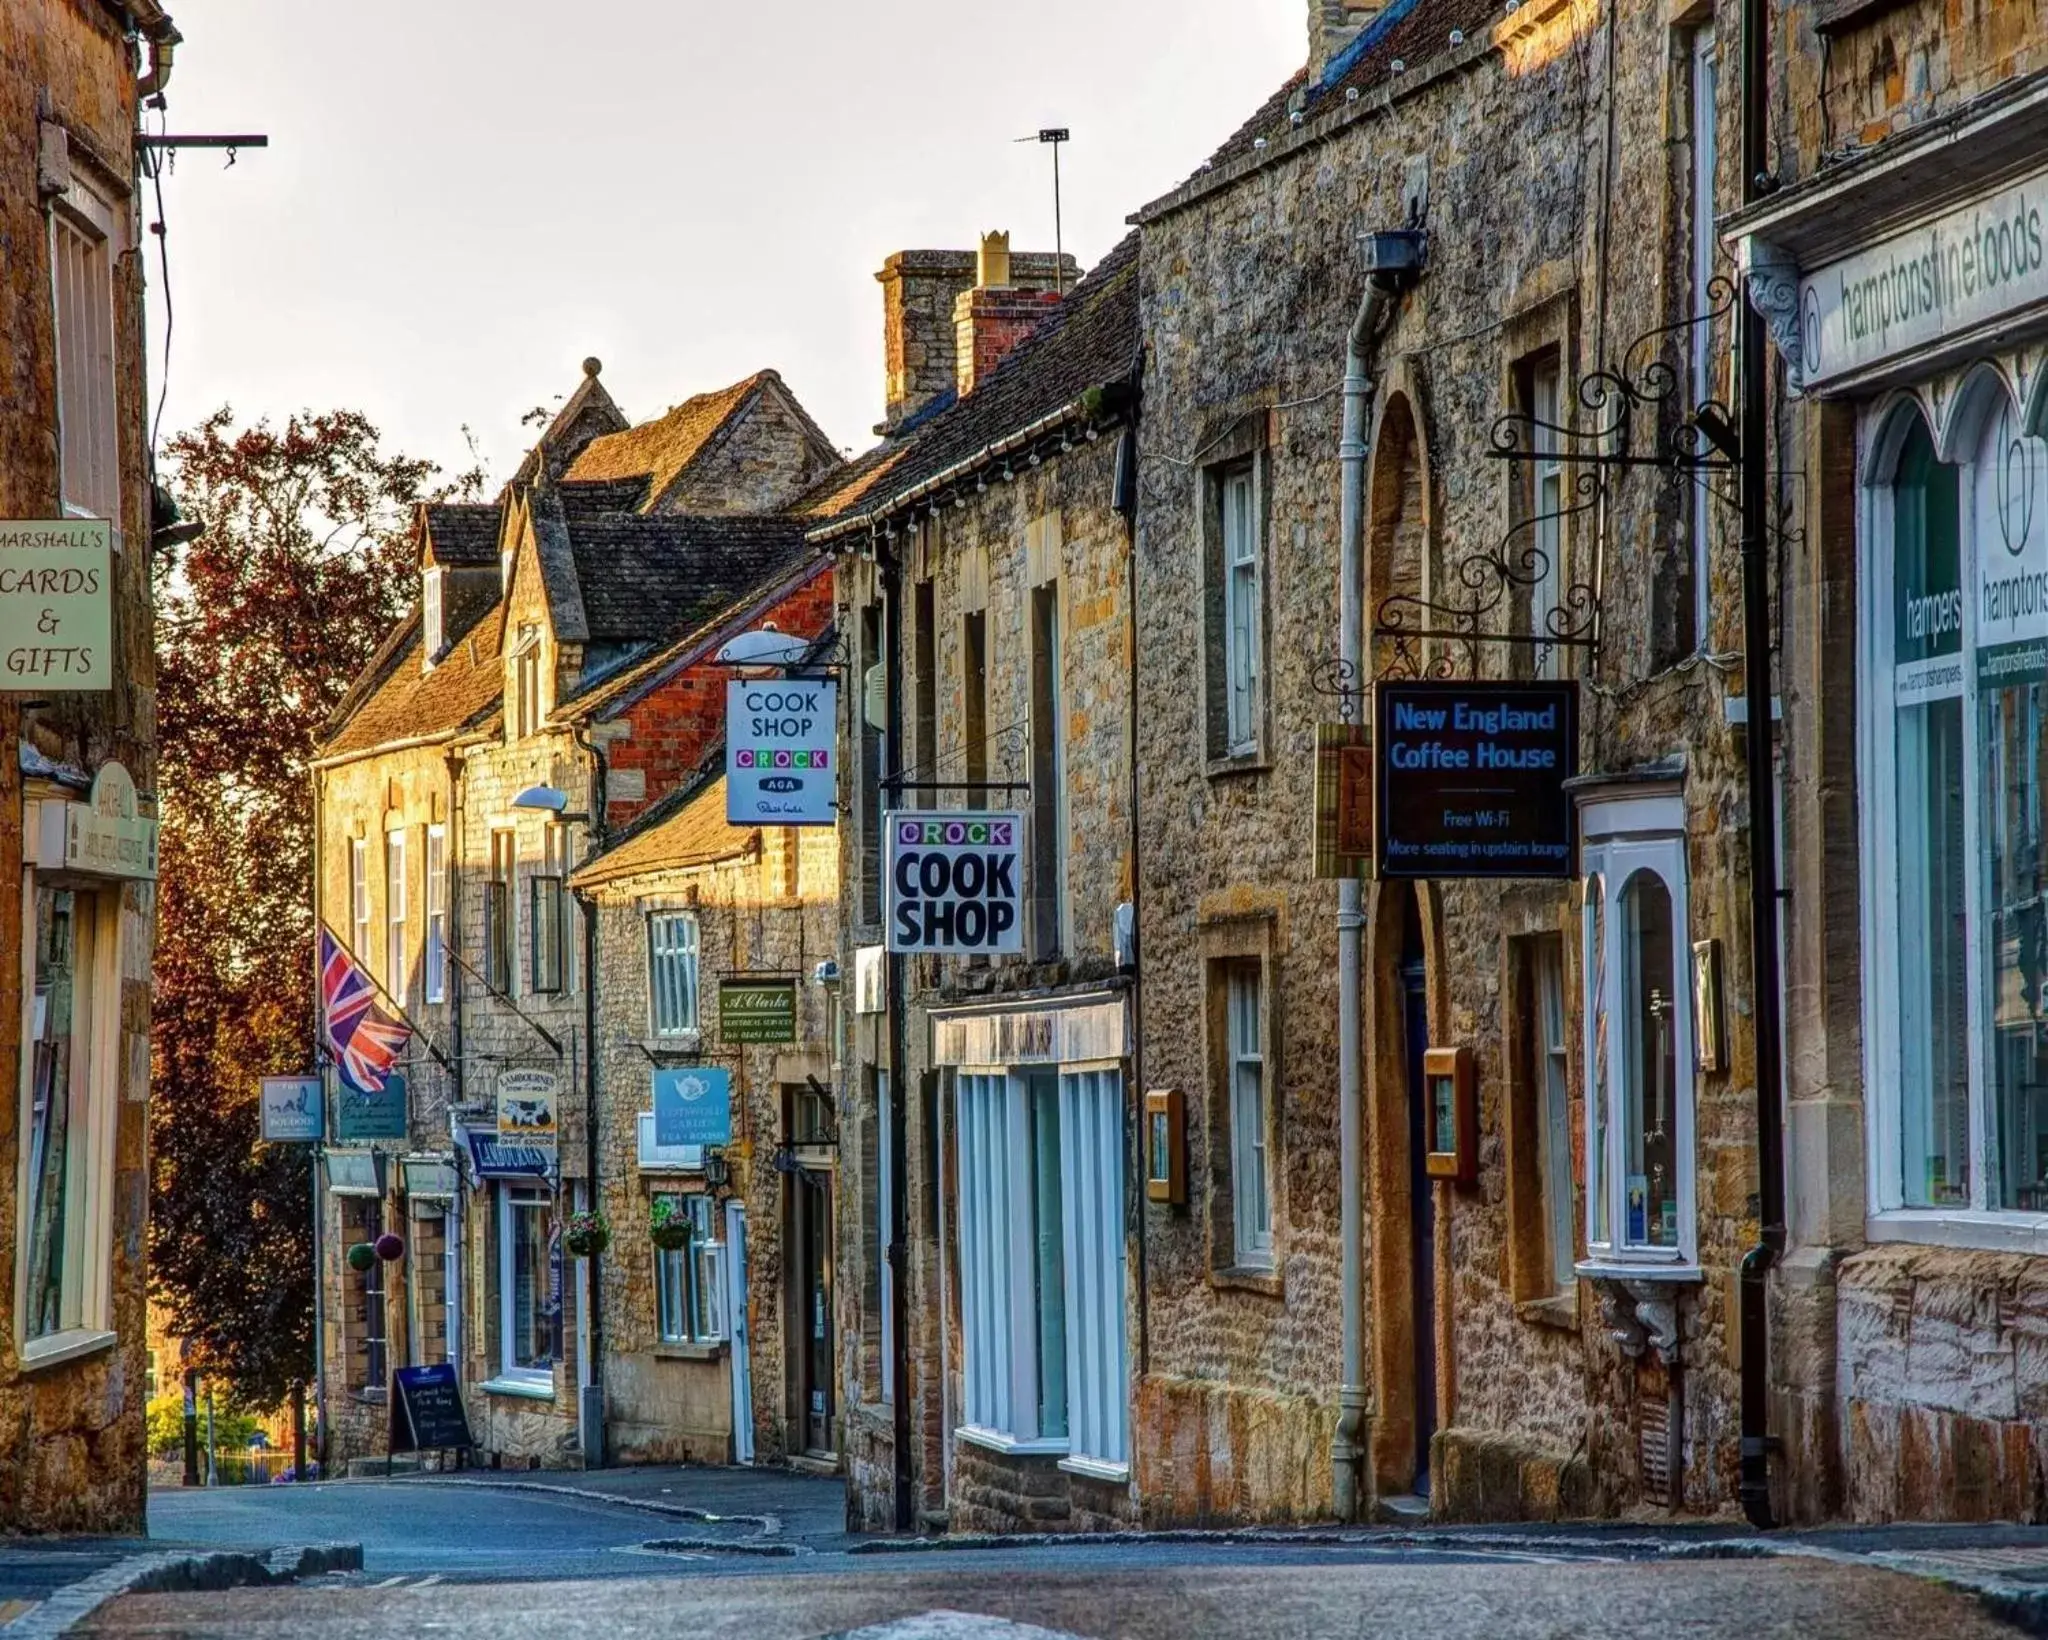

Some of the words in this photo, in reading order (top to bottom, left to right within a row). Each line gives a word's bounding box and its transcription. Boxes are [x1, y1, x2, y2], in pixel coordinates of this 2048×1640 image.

[0, 568, 99, 594] CARDS
[37, 608, 60, 635] &
[1906, 588, 1961, 648] hampers
[7, 646, 92, 677] GIFTS
[746, 692, 818, 712] COOK
[752, 718, 812, 737] SHOP
[1395, 702, 1447, 730] New
[1454, 702, 1556, 734] England
[737, 750, 826, 768] CROCK
[1391, 742, 1470, 769] Coffee
[1477, 742, 1556, 769] House
[1444, 809, 1472, 827] Free
[1475, 810, 1511, 827] Wi-Fi
[900, 822, 1012, 845] CROCK
[1387, 838, 1419, 856] More
[1424, 841, 1469, 858] seating
[1471, 840, 1481, 856] in
[1483, 840, 1528, 858] upstairs
[895, 852, 1017, 898] COOK
[896, 900, 1014, 946] SHOP
